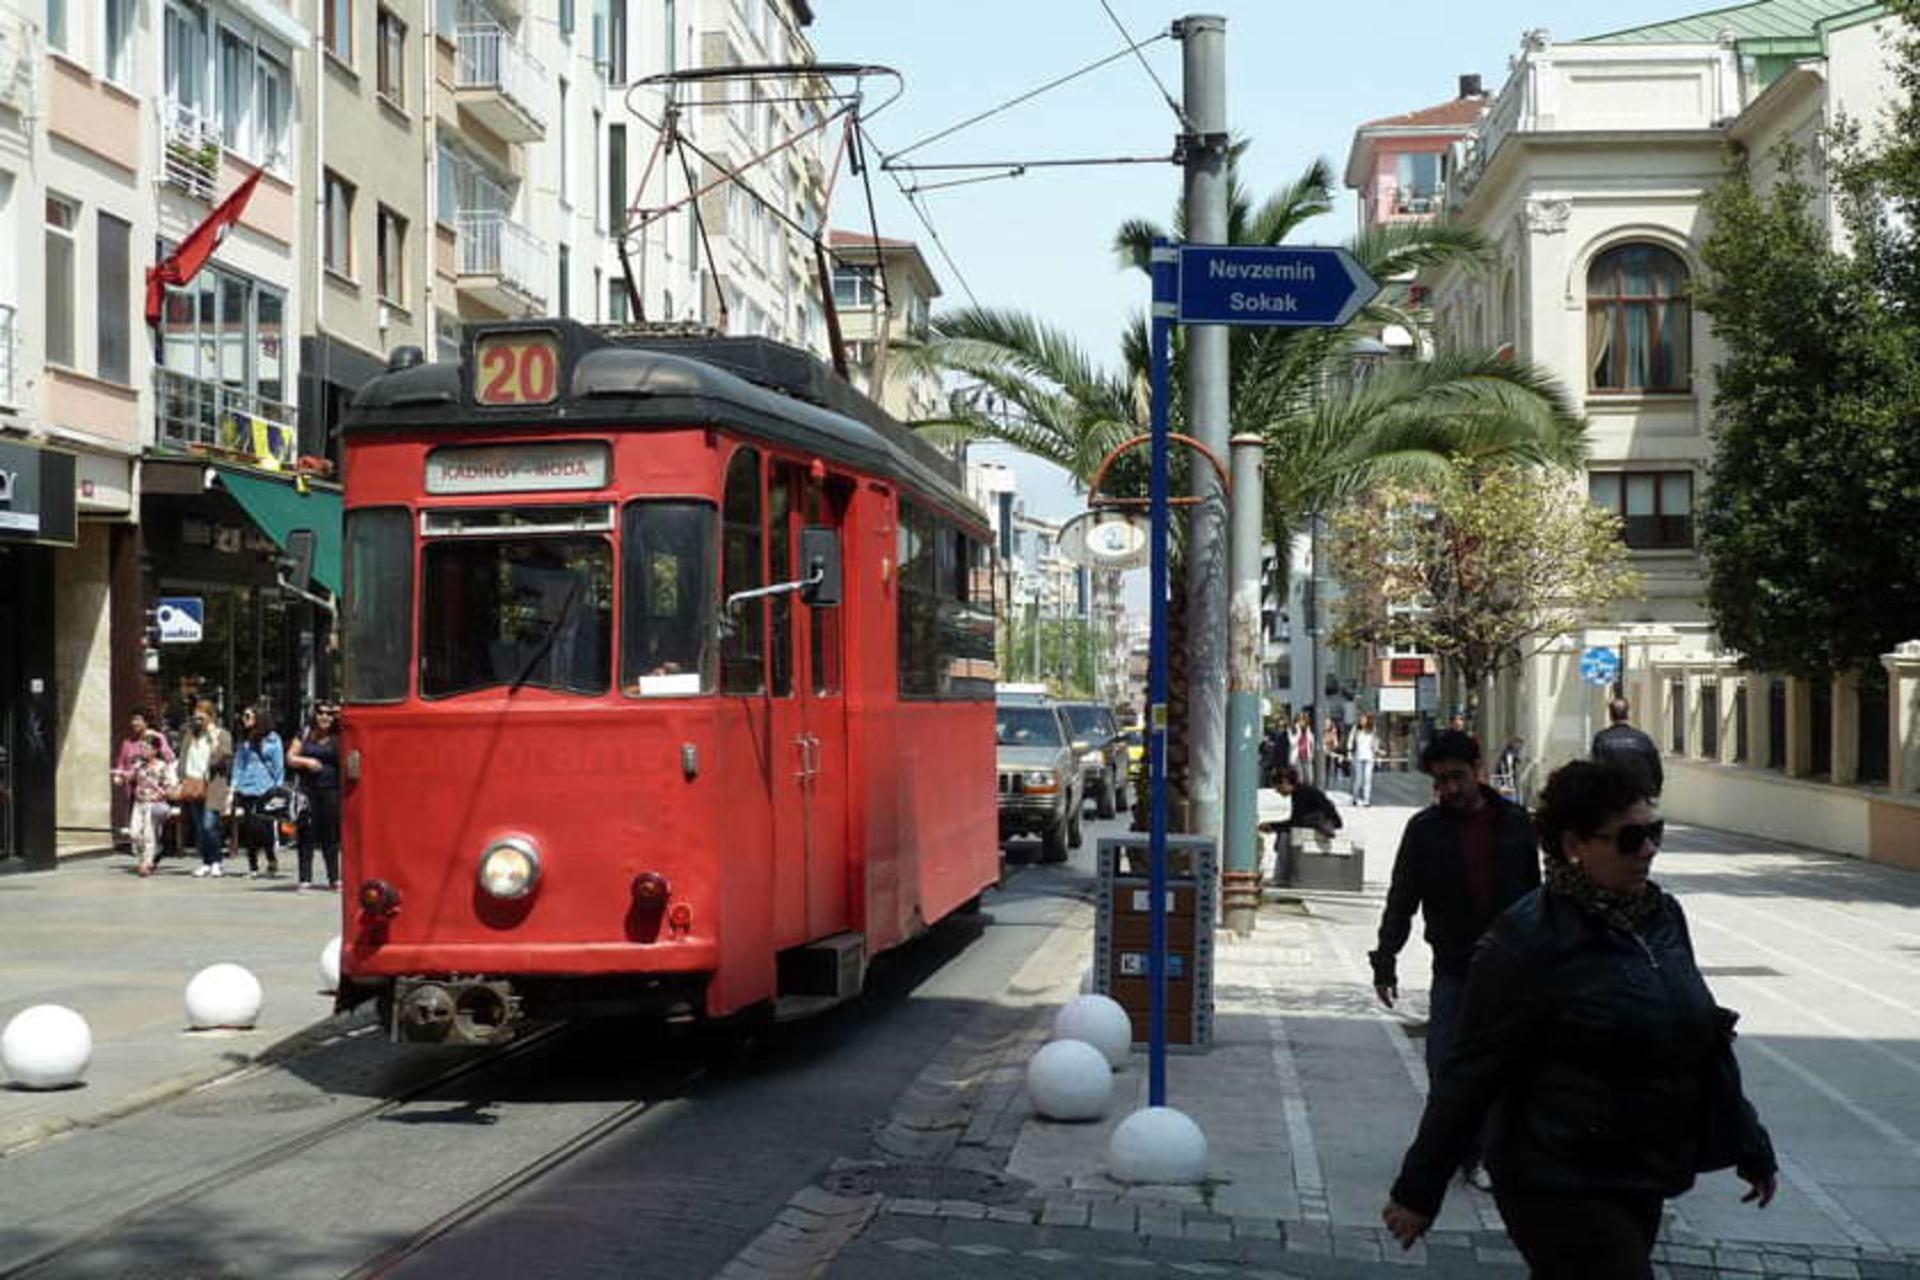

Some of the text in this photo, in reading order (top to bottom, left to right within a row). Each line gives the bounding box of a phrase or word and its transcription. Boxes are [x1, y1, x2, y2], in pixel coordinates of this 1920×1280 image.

[1209, 258, 1316, 281] Nevzemin
[1229, 292, 1298, 312] Sokak
[483, 345, 555, 403] 20
